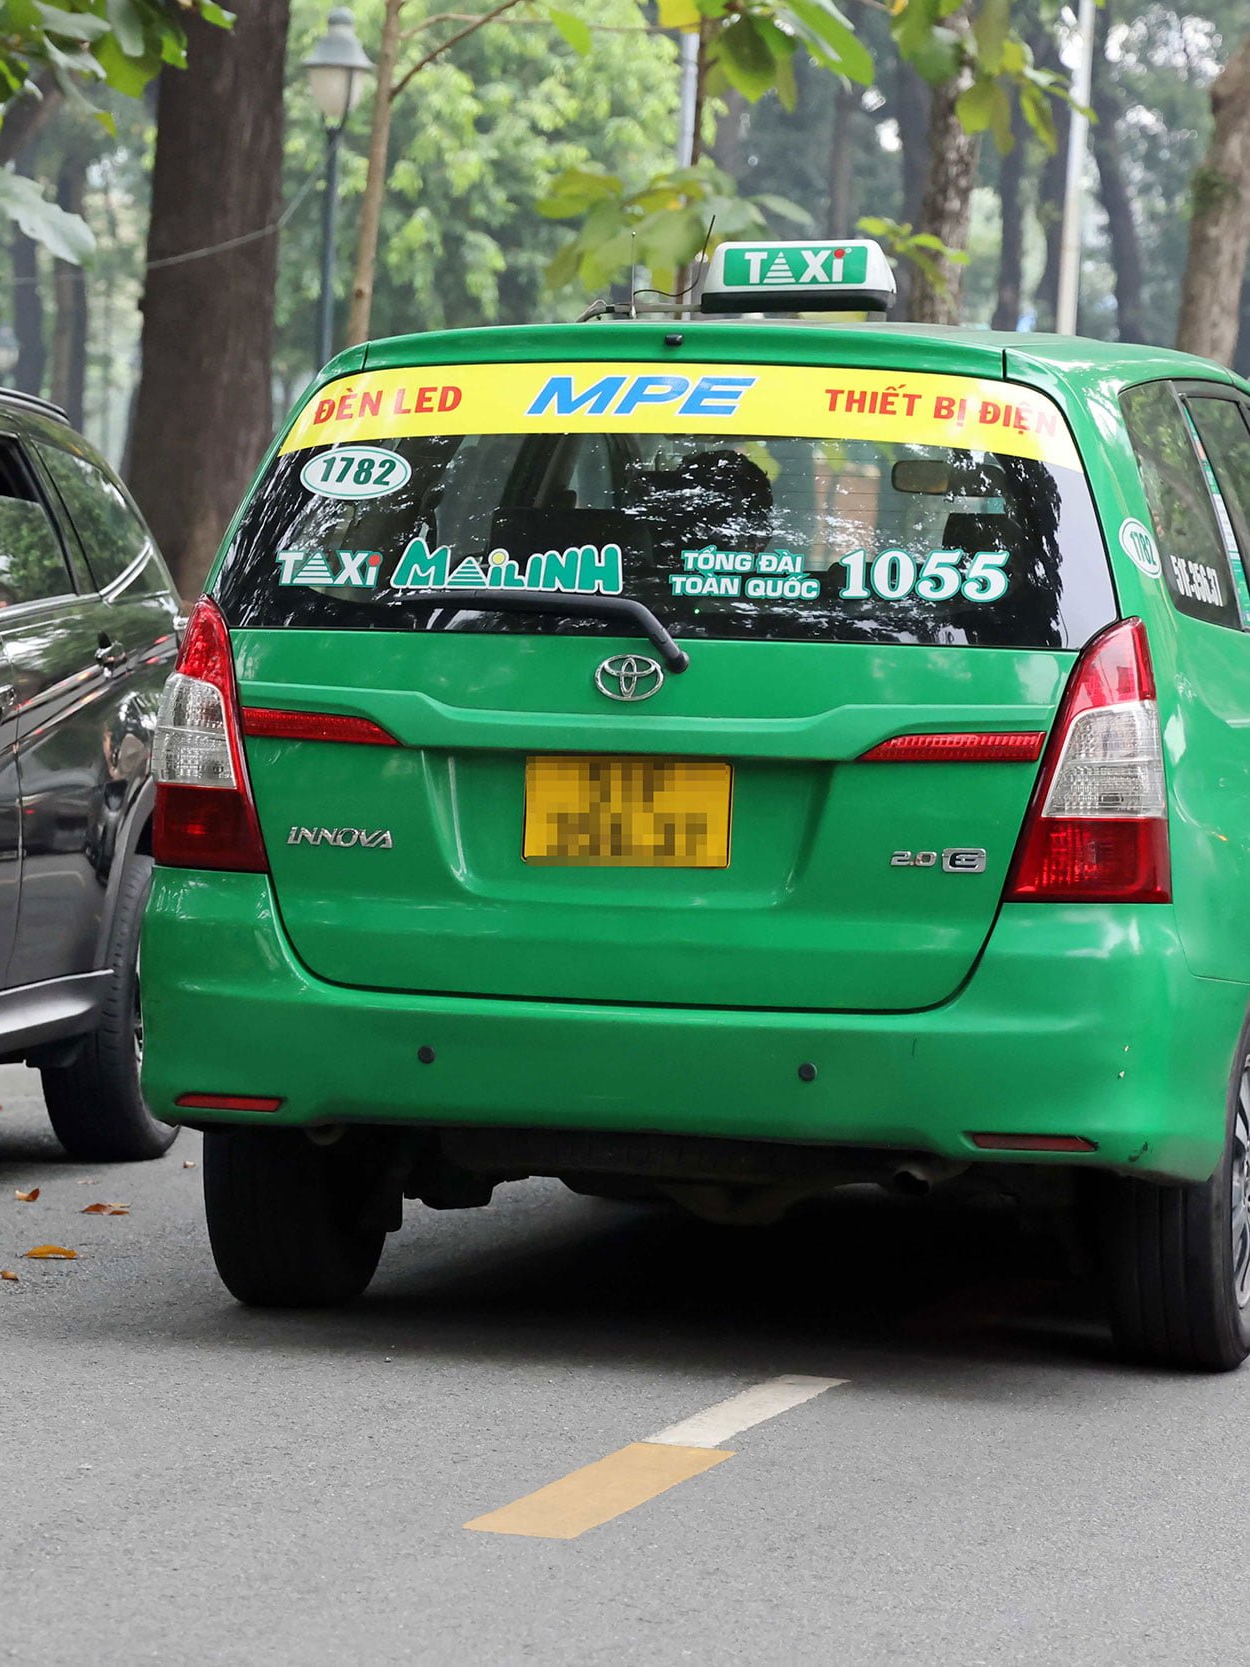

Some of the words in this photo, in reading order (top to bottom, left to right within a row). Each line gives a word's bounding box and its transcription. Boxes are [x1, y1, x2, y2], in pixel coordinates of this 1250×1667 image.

[313, 388, 383, 425] ĐÈN
[393, 385, 462, 415] LED
[525, 376, 755, 417] MPE
[825, 384, 922, 417] THIẾT
[933, 396, 966, 427] BỊ
[978, 400, 1057, 437] ĐIỆN
[320, 456, 396, 486] 1782
[682, 546, 752, 573] TỔNG
[757, 548, 804, 574] ĐÀI
[670, 574, 741, 596] TOÀN
[746, 574, 821, 599] QUỐC
[838, 549, 1010, 602] 1055
[286, 825, 393, 849] INNOVA
[890, 850, 937, 867] 2.0
